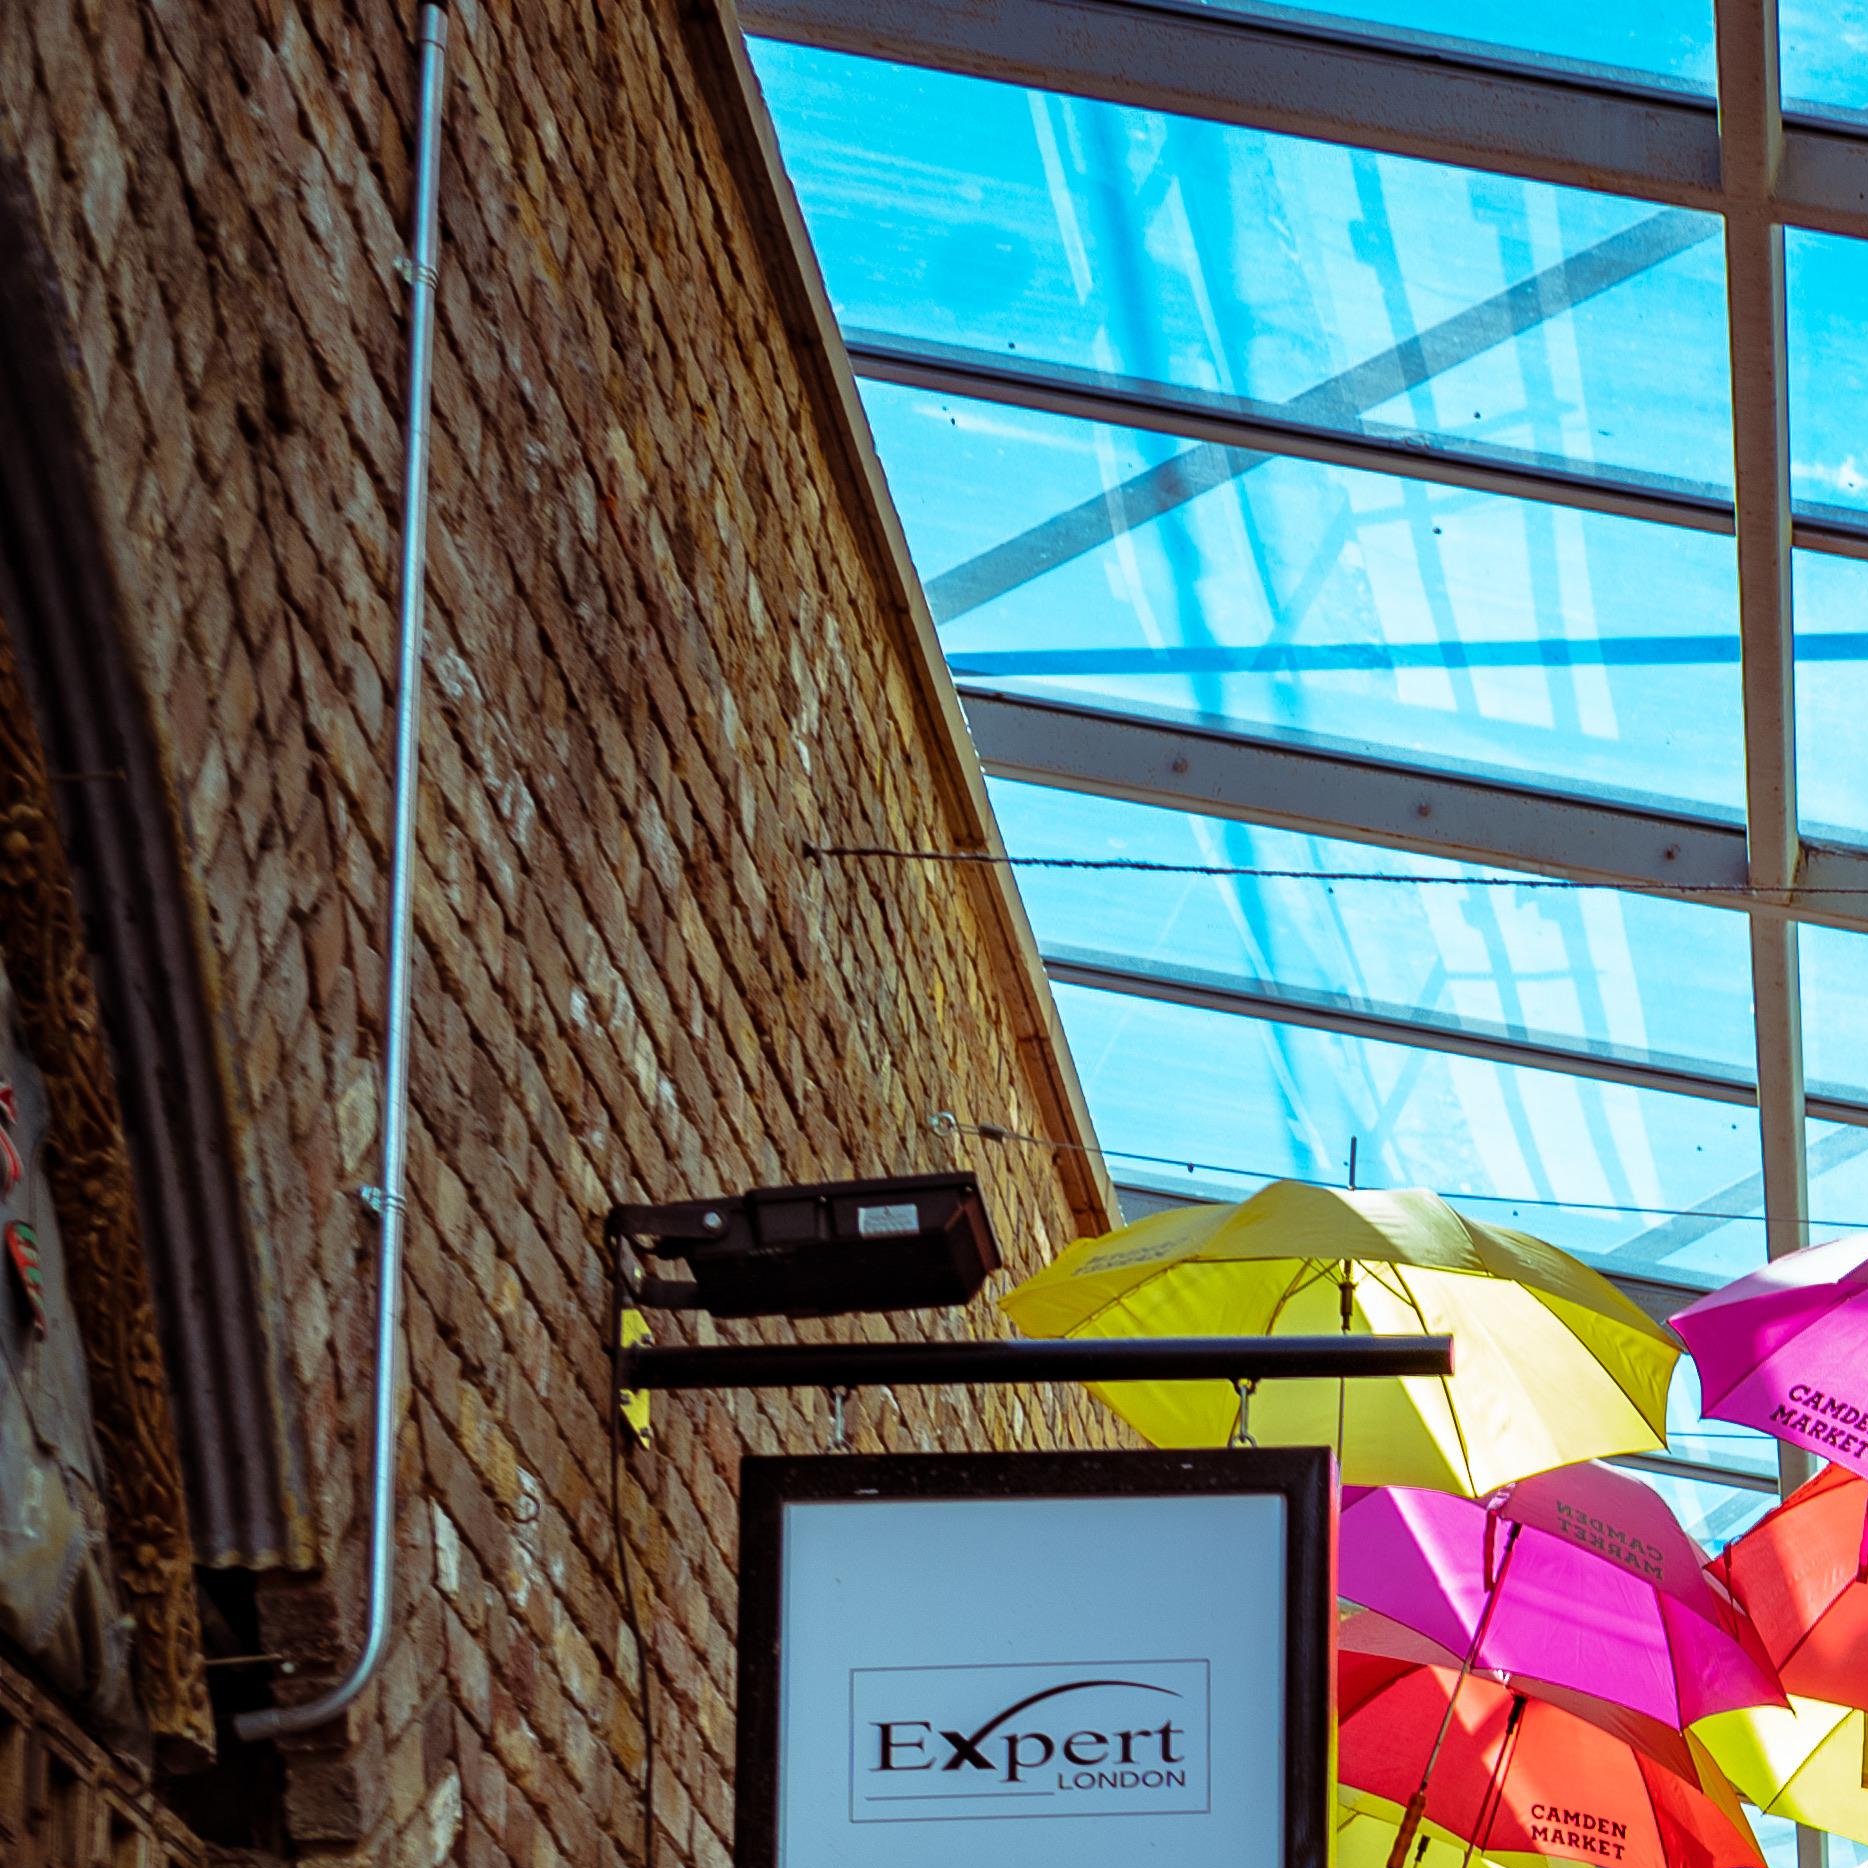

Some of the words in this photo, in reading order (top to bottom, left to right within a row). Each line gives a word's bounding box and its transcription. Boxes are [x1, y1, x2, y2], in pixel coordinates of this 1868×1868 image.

[868, 1717, 1186, 1783] Expert
[1056, 1768, 1187, 1792] LONDON
[1531, 1803, 1628, 1839] CAMDEN
[1530, 1825, 1625, 1860] MARKET
